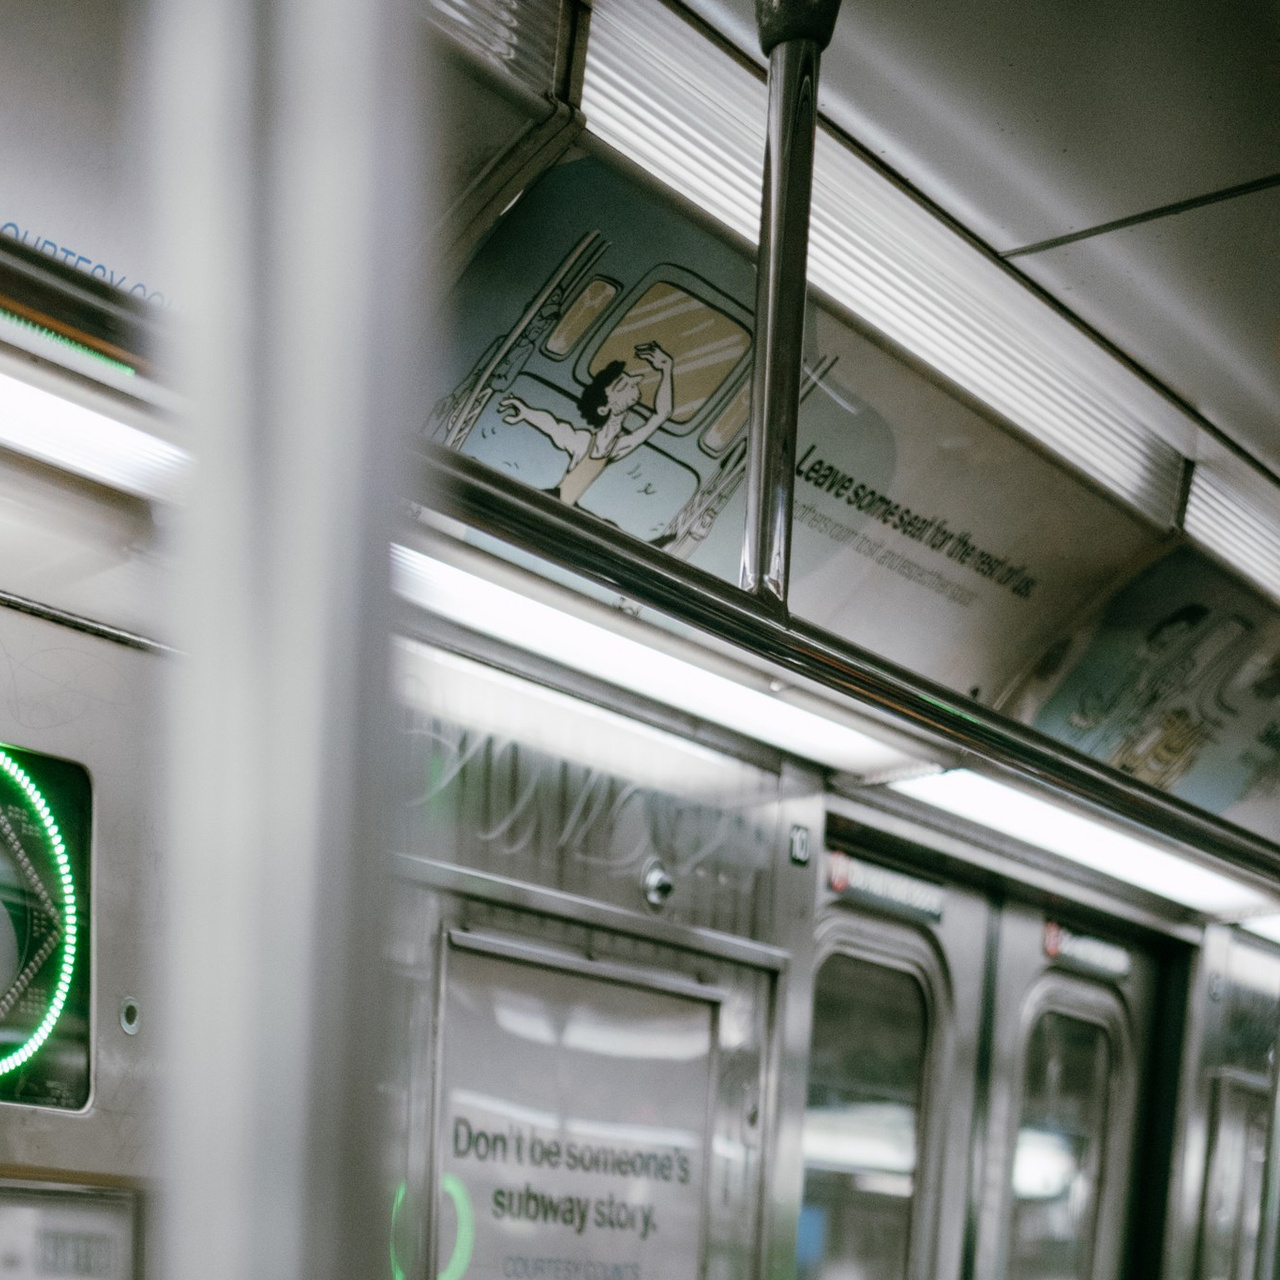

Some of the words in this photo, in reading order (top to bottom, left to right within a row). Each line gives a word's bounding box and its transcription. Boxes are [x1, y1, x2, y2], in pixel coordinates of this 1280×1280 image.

[795, 444, 854, 498] Leave
[846, 483, 900, 525] some
[452, 1115, 524, 1166] Don't
[529, 1125, 562, 1170] be
[565, 1141, 691, 1185] someone's
[491, 1182, 590, 1236] subway
[594, 1191, 658, 1241] story.
